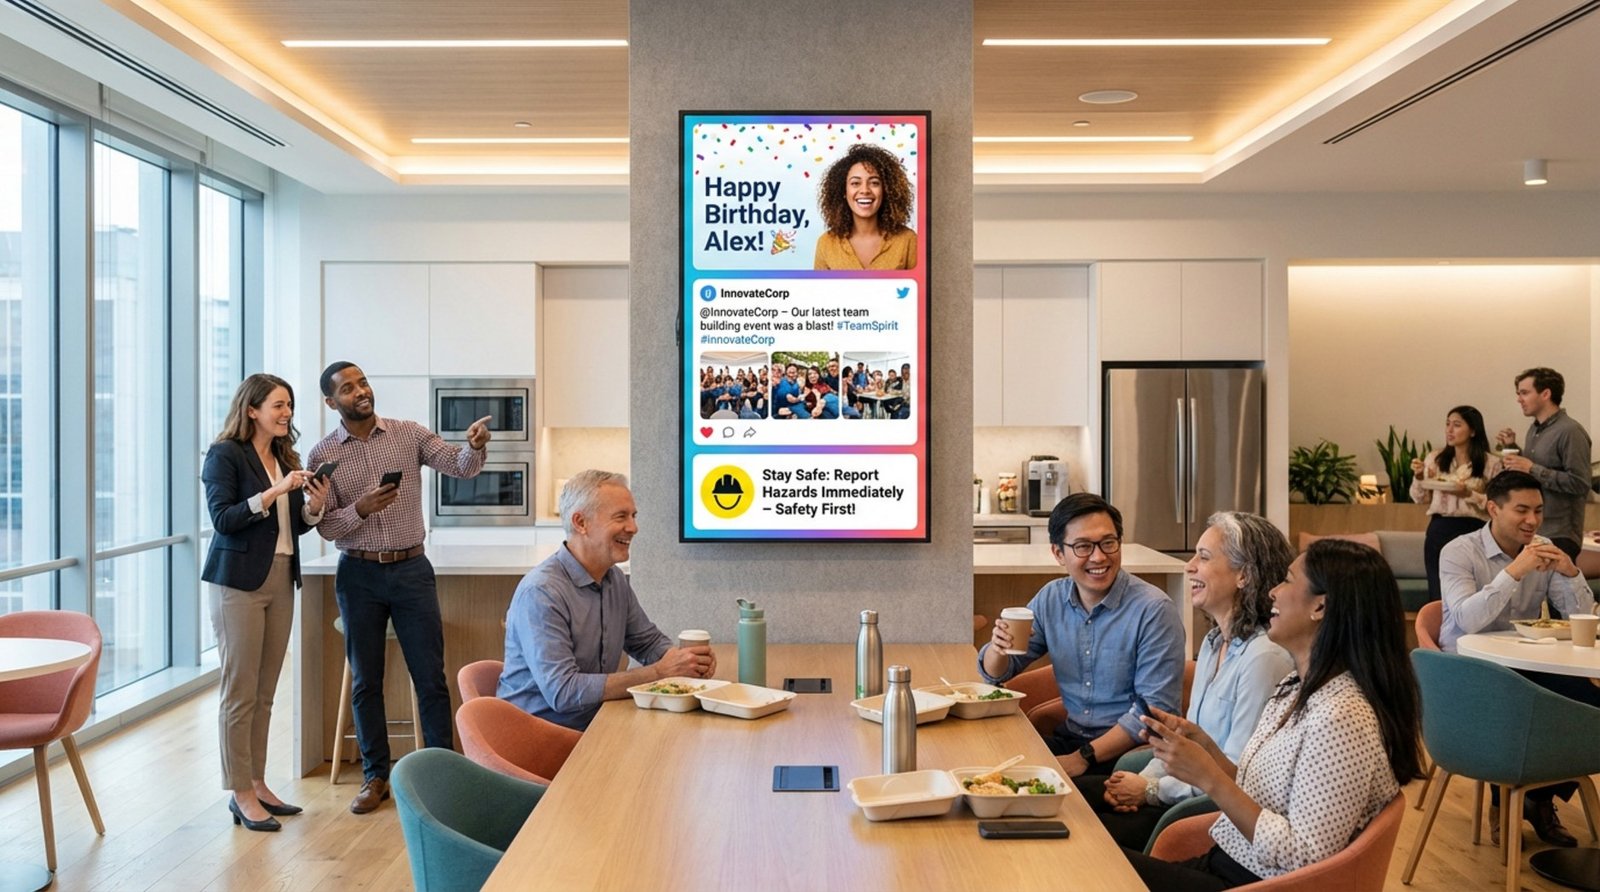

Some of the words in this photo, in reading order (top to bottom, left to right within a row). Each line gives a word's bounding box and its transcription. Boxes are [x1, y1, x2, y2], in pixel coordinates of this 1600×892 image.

[705, 177, 781, 201] Happy
[705, 203, 810, 229] Birthday,
[704, 230, 764, 251] Alex!
[720, 288, 790, 300] InnovateCorp
[700, 307, 779, 319] @InnovateCorp
[791, 307, 810, 317] Our
[812, 307, 840, 317] latest
[843, 308, 869, 317] team
[700, 320, 740, 333] building
[743, 322, 771, 331] event
[773, 323, 794, 331] was
[797, 323, 803, 331] a
[806, 320, 834, 331] blast!
[837, 321, 899, 332] #TeamSpirit
[762, 469, 792, 482] Stay
[796, 468, 830, 481] Safe:
[834, 469, 879, 483] Report
[763, 485, 818, 498] Hazards
[822, 485, 904, 501] Immediately
[775, 502, 818, 518] Safety
[822, 502, 856, 515] First!
